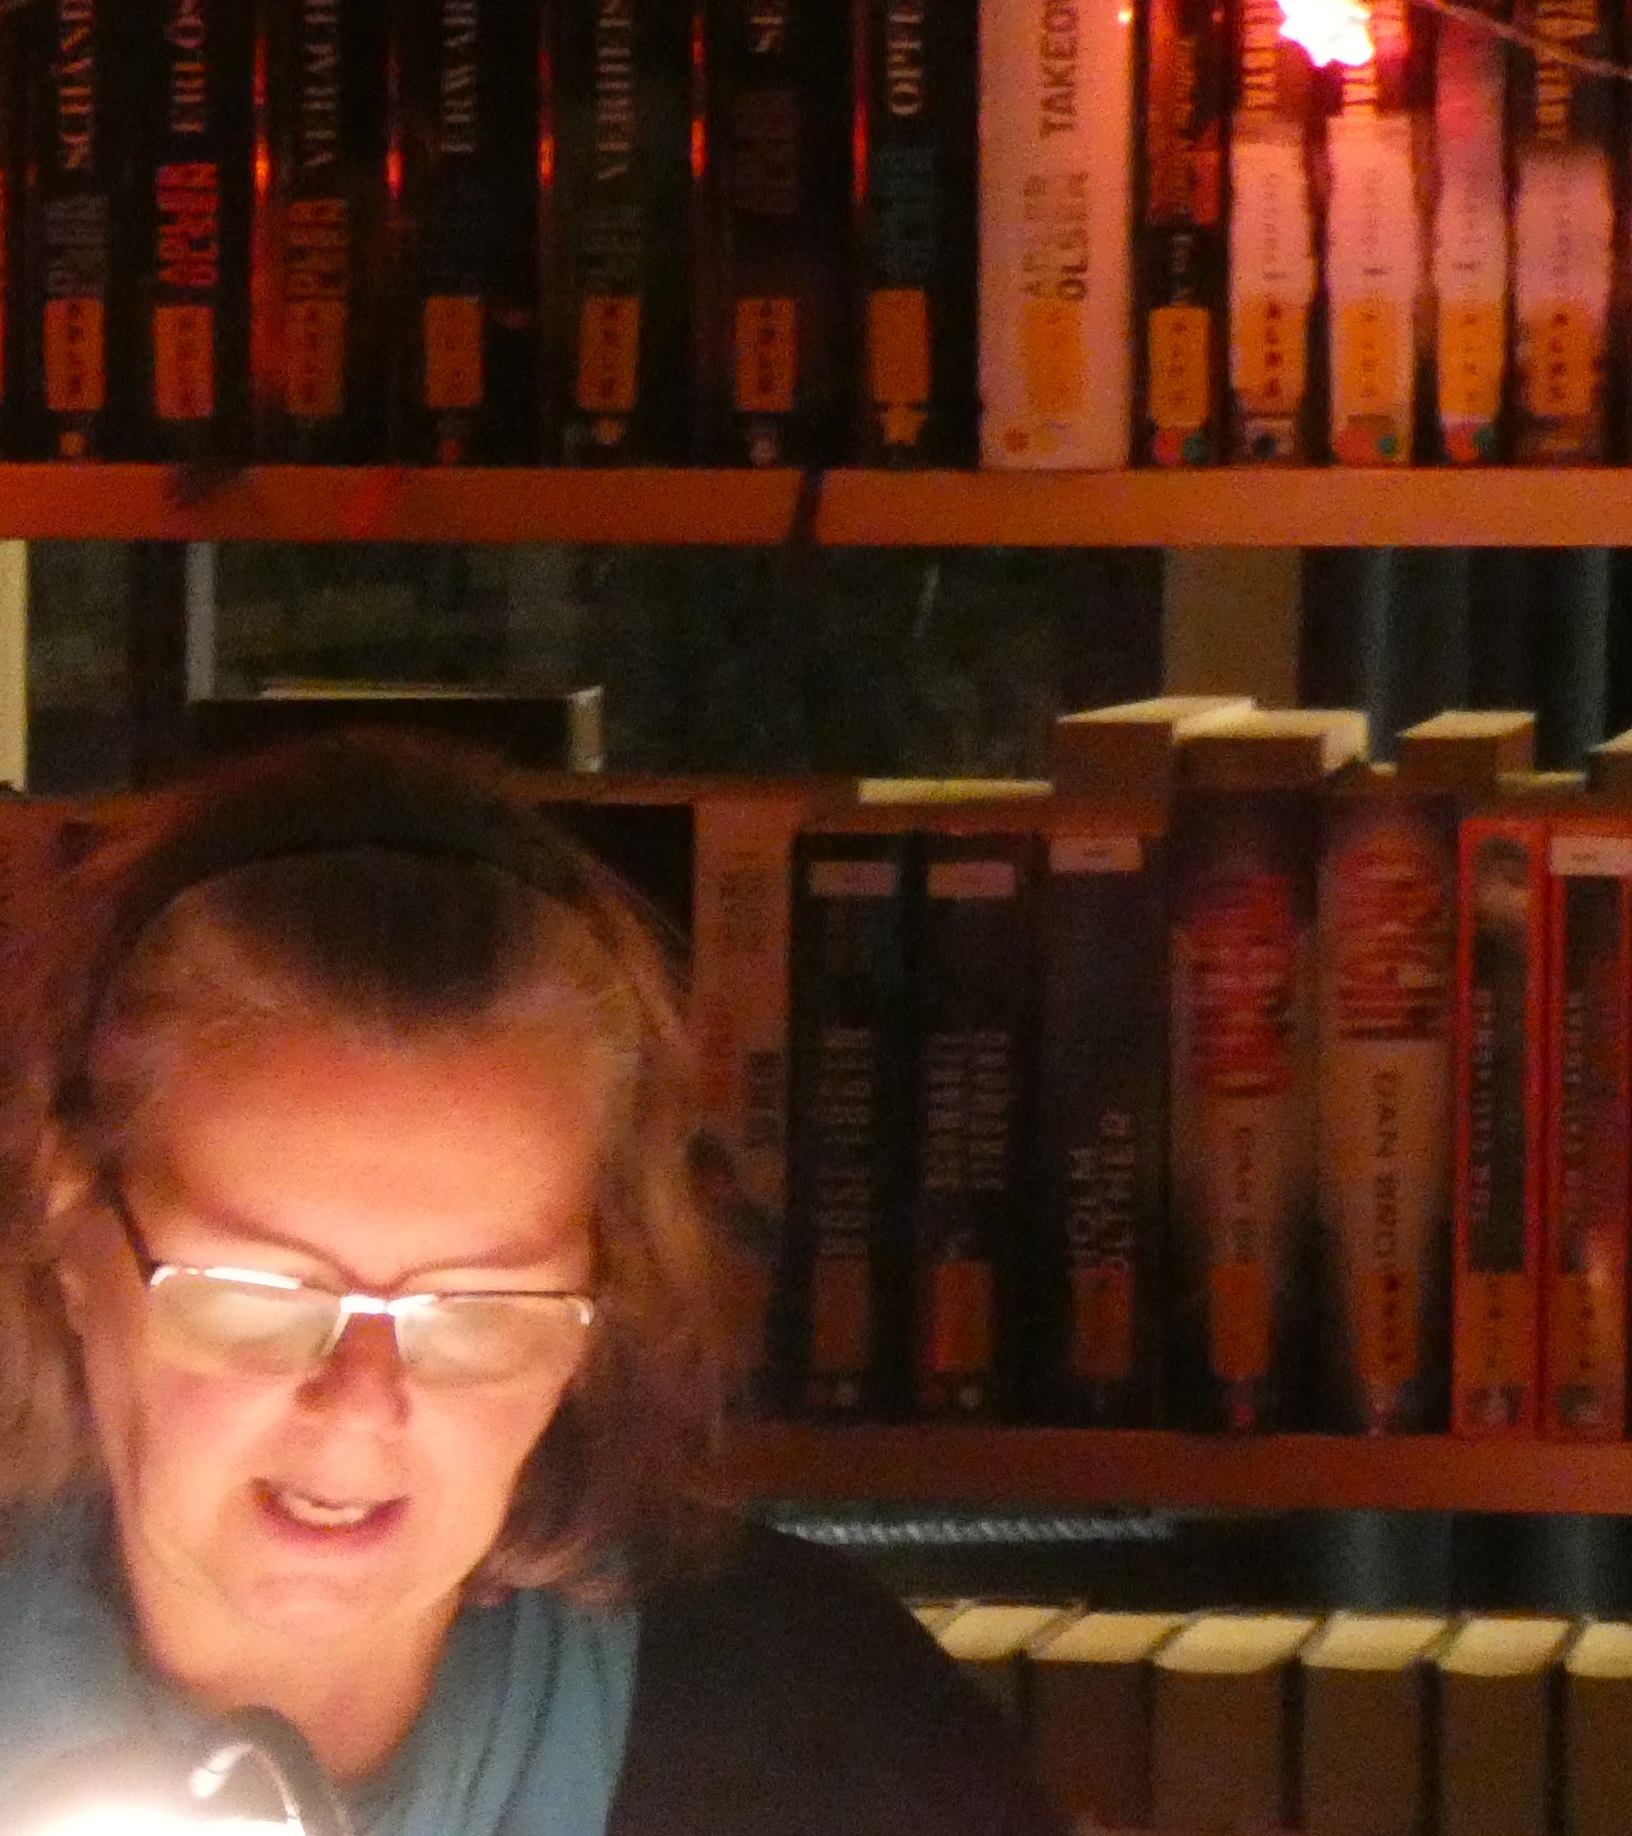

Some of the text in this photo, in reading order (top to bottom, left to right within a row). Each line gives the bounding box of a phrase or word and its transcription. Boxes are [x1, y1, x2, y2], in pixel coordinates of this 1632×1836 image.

[1052, 171, 1090, 302] OLSEN
[1373, 1071, 1402, 1273] DAN BRO
